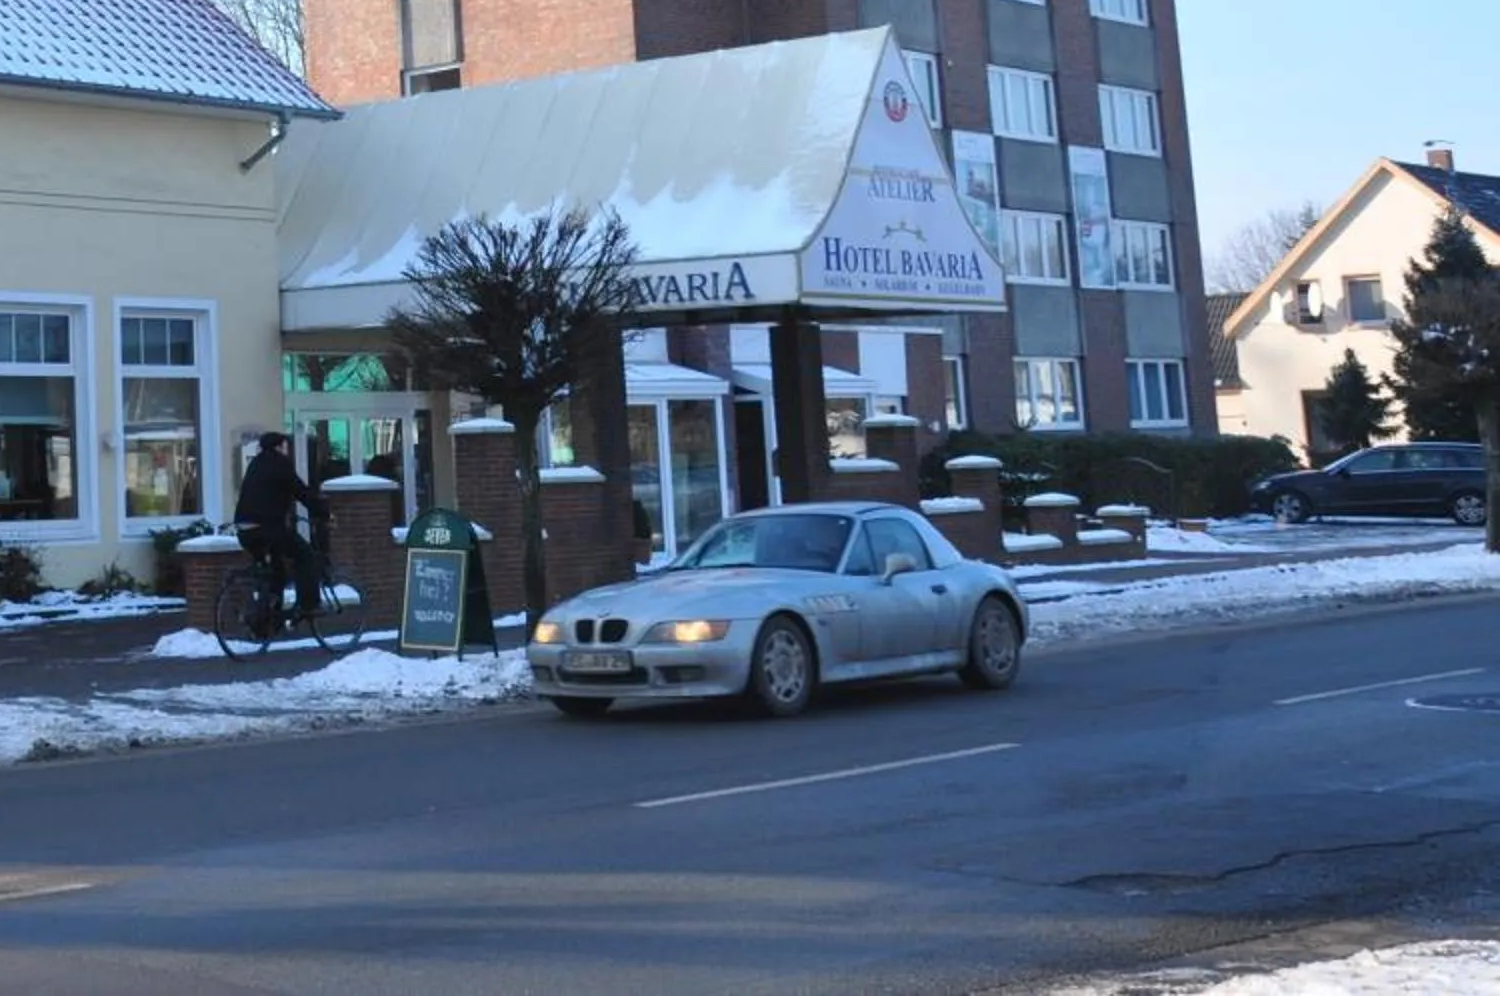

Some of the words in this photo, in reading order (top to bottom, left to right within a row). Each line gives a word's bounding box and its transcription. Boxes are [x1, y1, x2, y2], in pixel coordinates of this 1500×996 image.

[867, 174, 936, 203] ATELIER
[823, 236, 898, 275] HOTEL
[901, 249, 984, 281] BAVARIA
